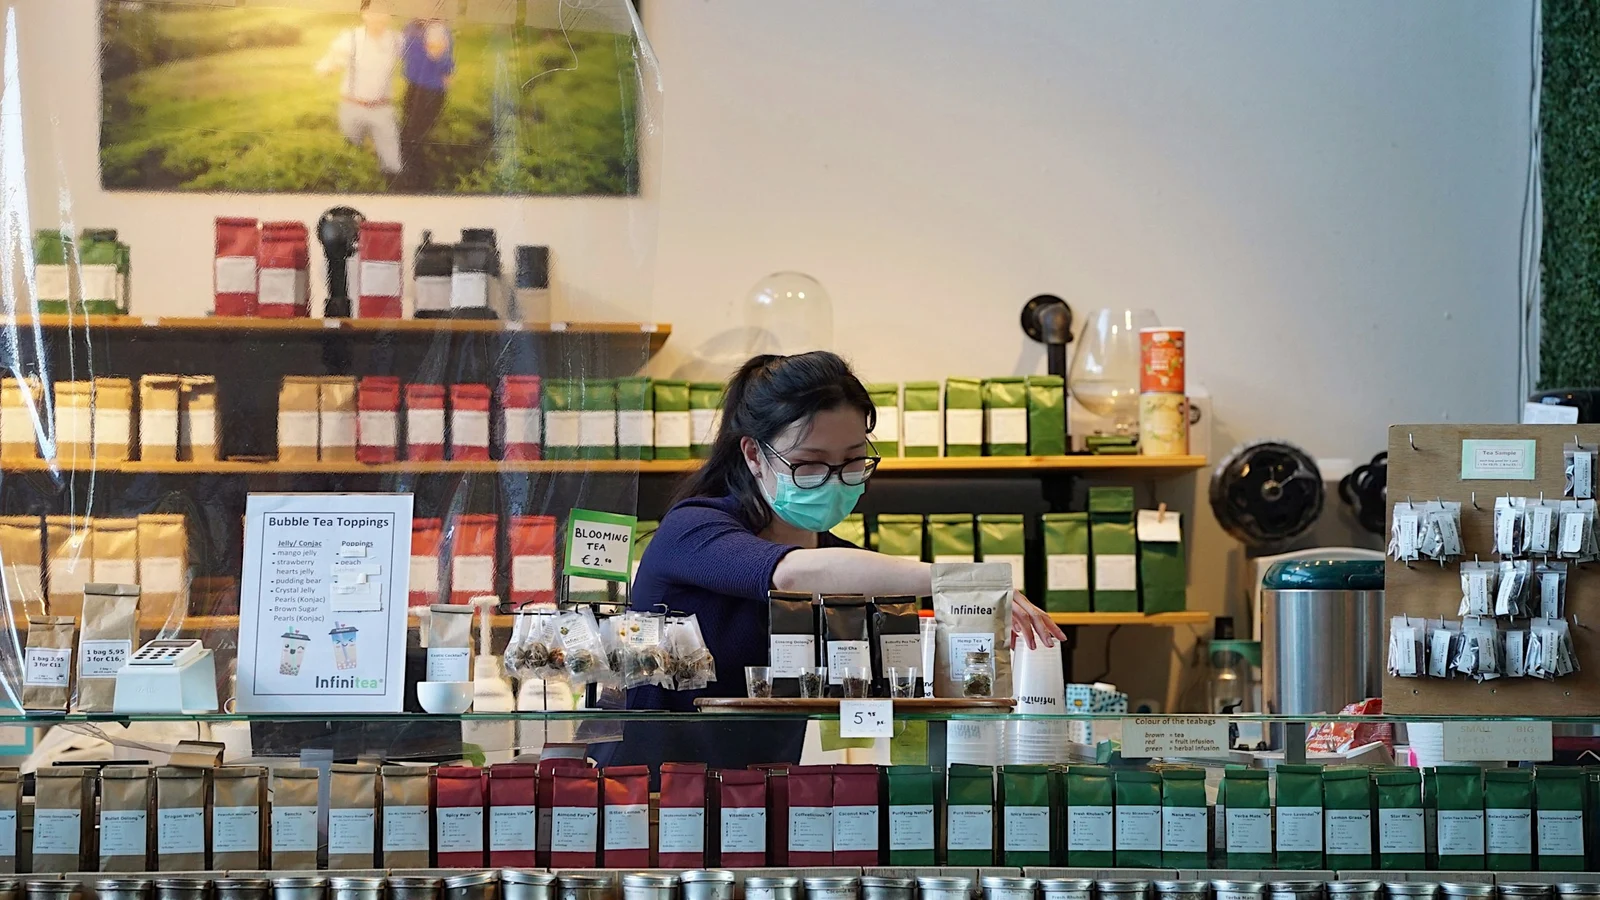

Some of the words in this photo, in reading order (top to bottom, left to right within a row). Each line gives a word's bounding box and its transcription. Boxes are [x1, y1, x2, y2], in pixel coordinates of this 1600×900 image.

[269, 517, 309, 526] Bubble
[313, 517, 333, 526] Tea
[337, 517, 389, 528] Toppings
[575, 528, 628, 542] BLOOMING
[587, 542, 606, 552] TEA
[950, 605, 992, 615] Infinitea
[316, 676, 378, 689] Infinitea
